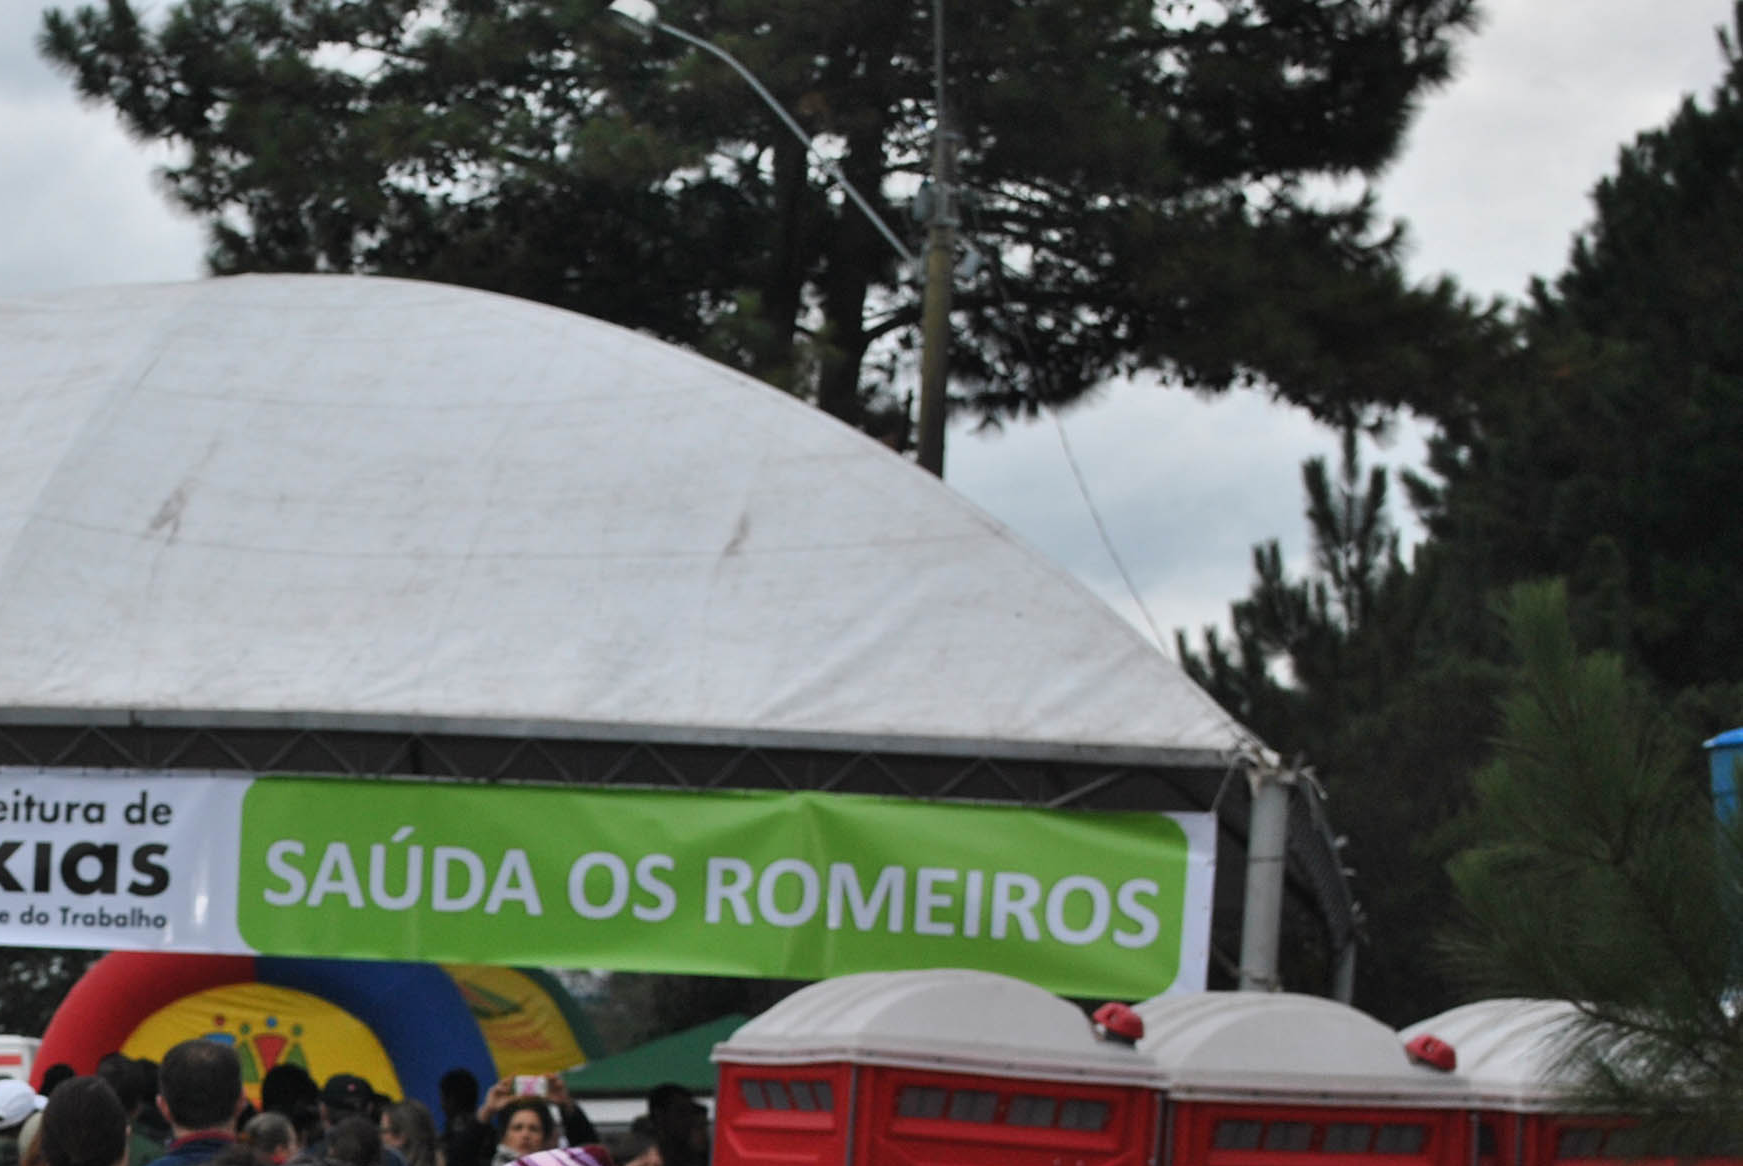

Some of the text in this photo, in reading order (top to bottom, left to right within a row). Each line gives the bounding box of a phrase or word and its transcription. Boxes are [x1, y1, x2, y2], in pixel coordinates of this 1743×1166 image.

[124, 790, 172, 825] de
[263, 826, 1160, 949] SAÚDA OS ROMEIROS
[19, 905, 49, 926] do
[60, 907, 167, 929] Trabalho
